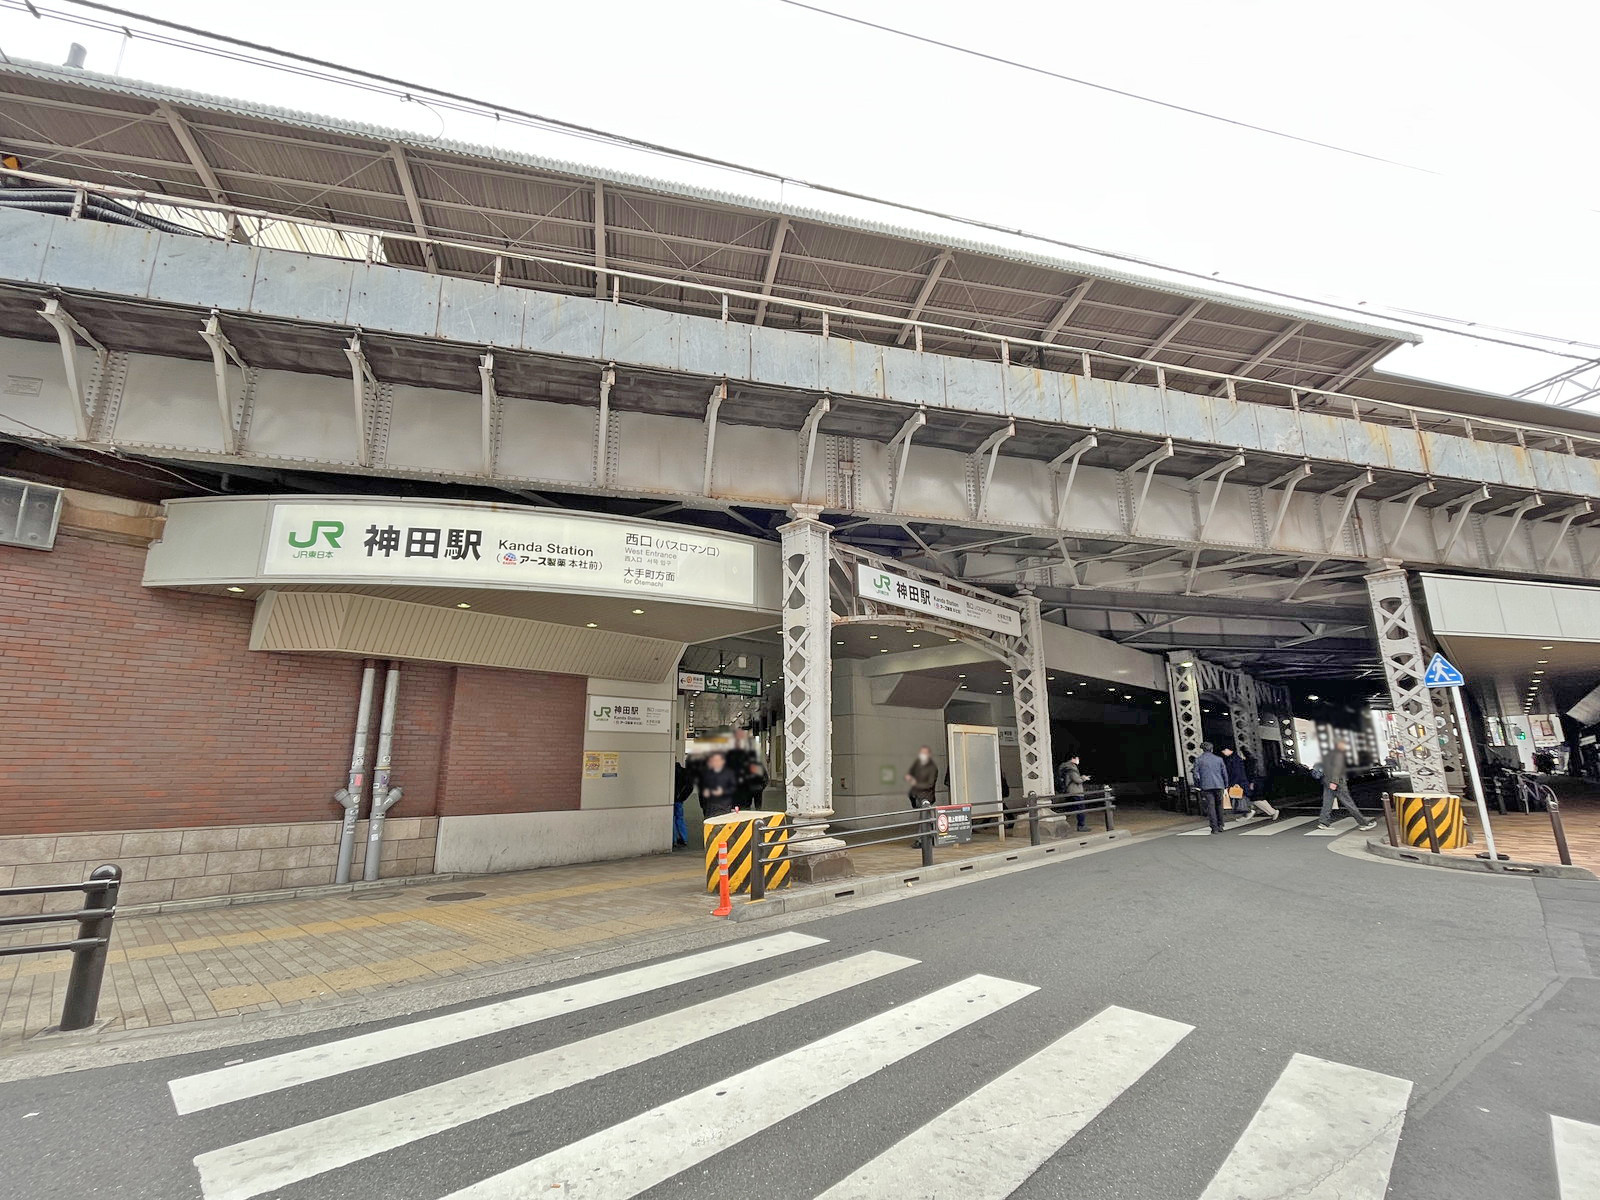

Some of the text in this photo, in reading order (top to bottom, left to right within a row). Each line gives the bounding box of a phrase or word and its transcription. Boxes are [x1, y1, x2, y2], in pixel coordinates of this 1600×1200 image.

[288, 520, 345, 549] JR
[625, 533, 652, 548] 西口
[363, 524, 483, 561] 神田駅
[498, 539, 594, 557] Kanda Station
[624, 547, 678, 560] West Entrance
[624, 567, 676, 582] 大手町方面
[873, 574, 891, 592] JR
[896, 581, 931, 606] 神田駅
[706, 677, 720, 687] JR
[593, 706, 612, 718] JR
[614, 705, 639, 715] 神田駅
